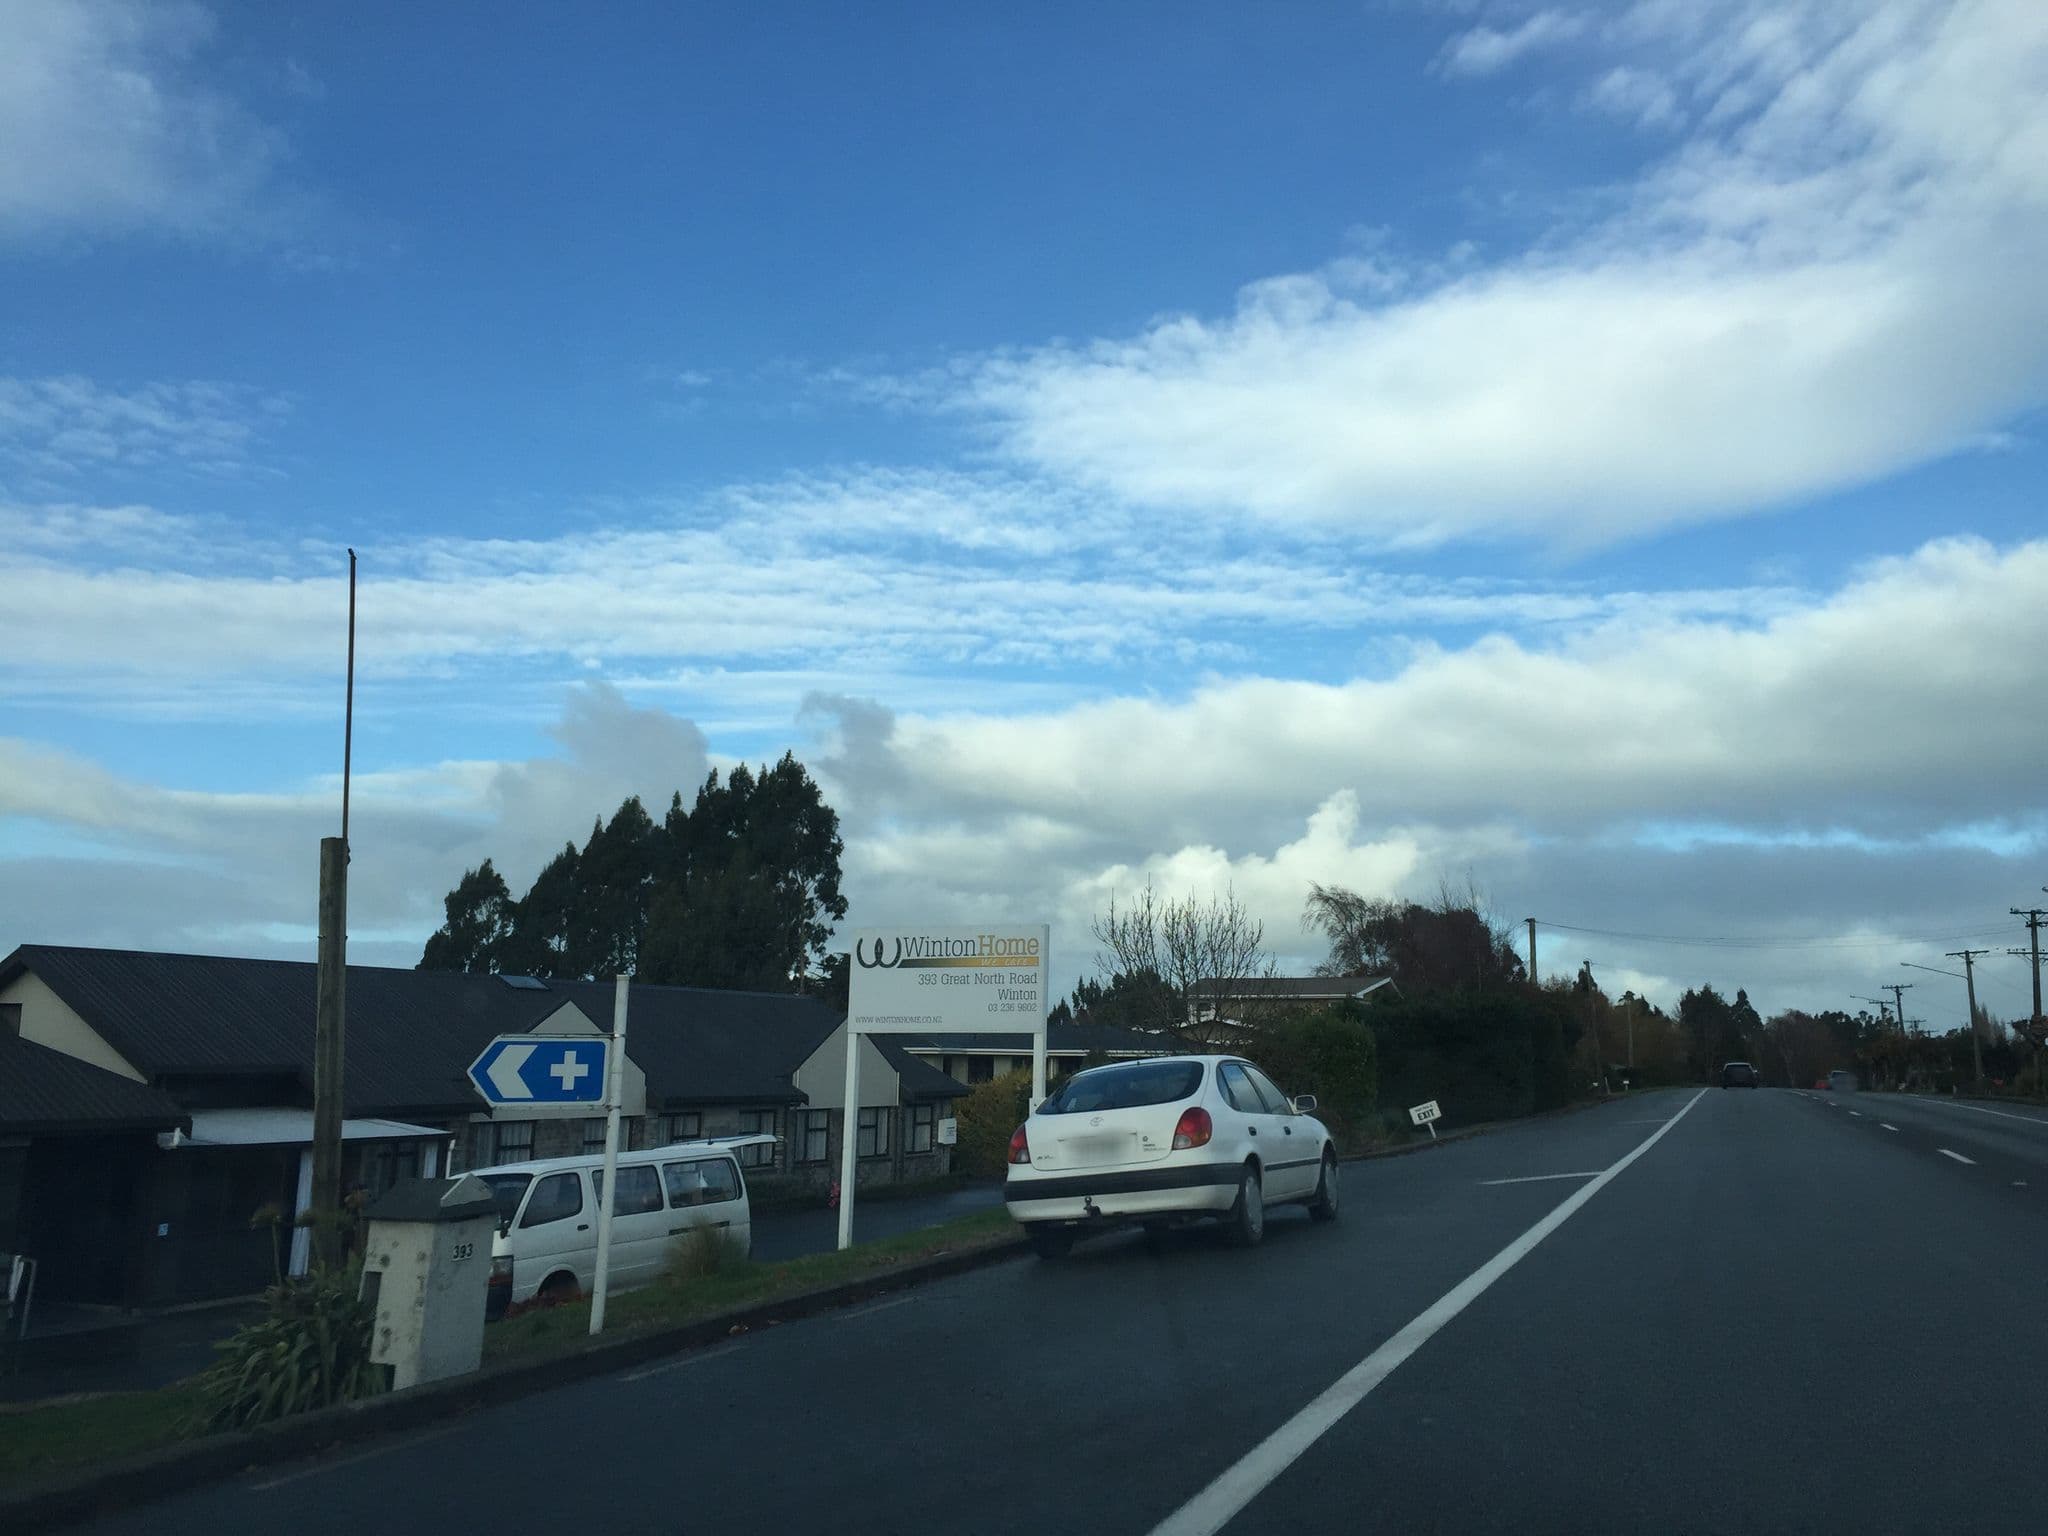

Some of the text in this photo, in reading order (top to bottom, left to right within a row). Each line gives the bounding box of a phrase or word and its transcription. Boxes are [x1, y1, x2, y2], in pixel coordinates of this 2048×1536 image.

[903, 935, 1040, 957] WintonHome
[918, 972, 1037, 985] 393 Great North Road
[997, 988, 1037, 1000] Winton
[988, 1003, 998, 1012] 03
[1000, 1003, 1015, 1012] 236
[1417, 1108, 1434, 1120] EXIT
[452, 1243, 473, 1259] 393
